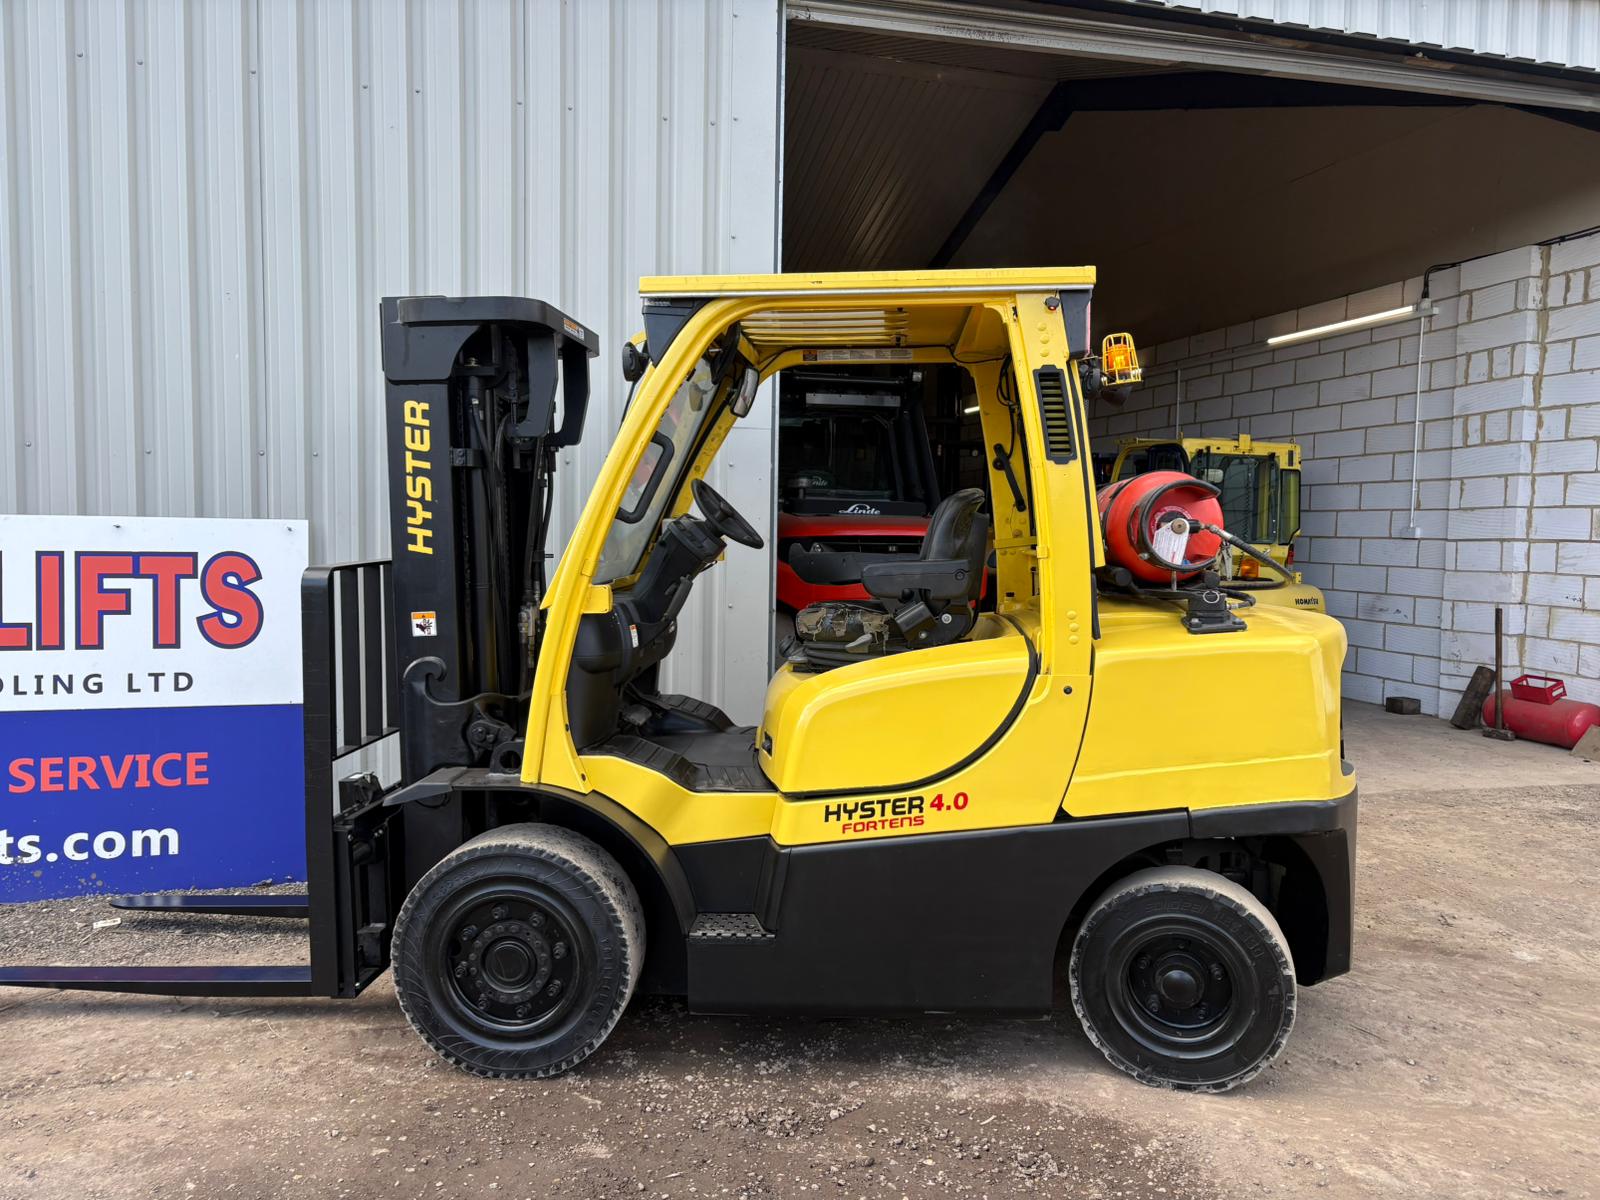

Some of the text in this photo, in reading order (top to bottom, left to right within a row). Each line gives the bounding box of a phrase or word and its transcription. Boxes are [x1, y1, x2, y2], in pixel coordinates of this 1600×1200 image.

[403, 400, 434, 555] HYSTER
[838, 503, 881, 515] Linde
[0, 671, 194, 695] LING LTD
[8, 751, 209, 794] SERVICE
[824, 791, 969, 823] HYSTER 4.0
[841, 815, 925, 834] FORTENS
